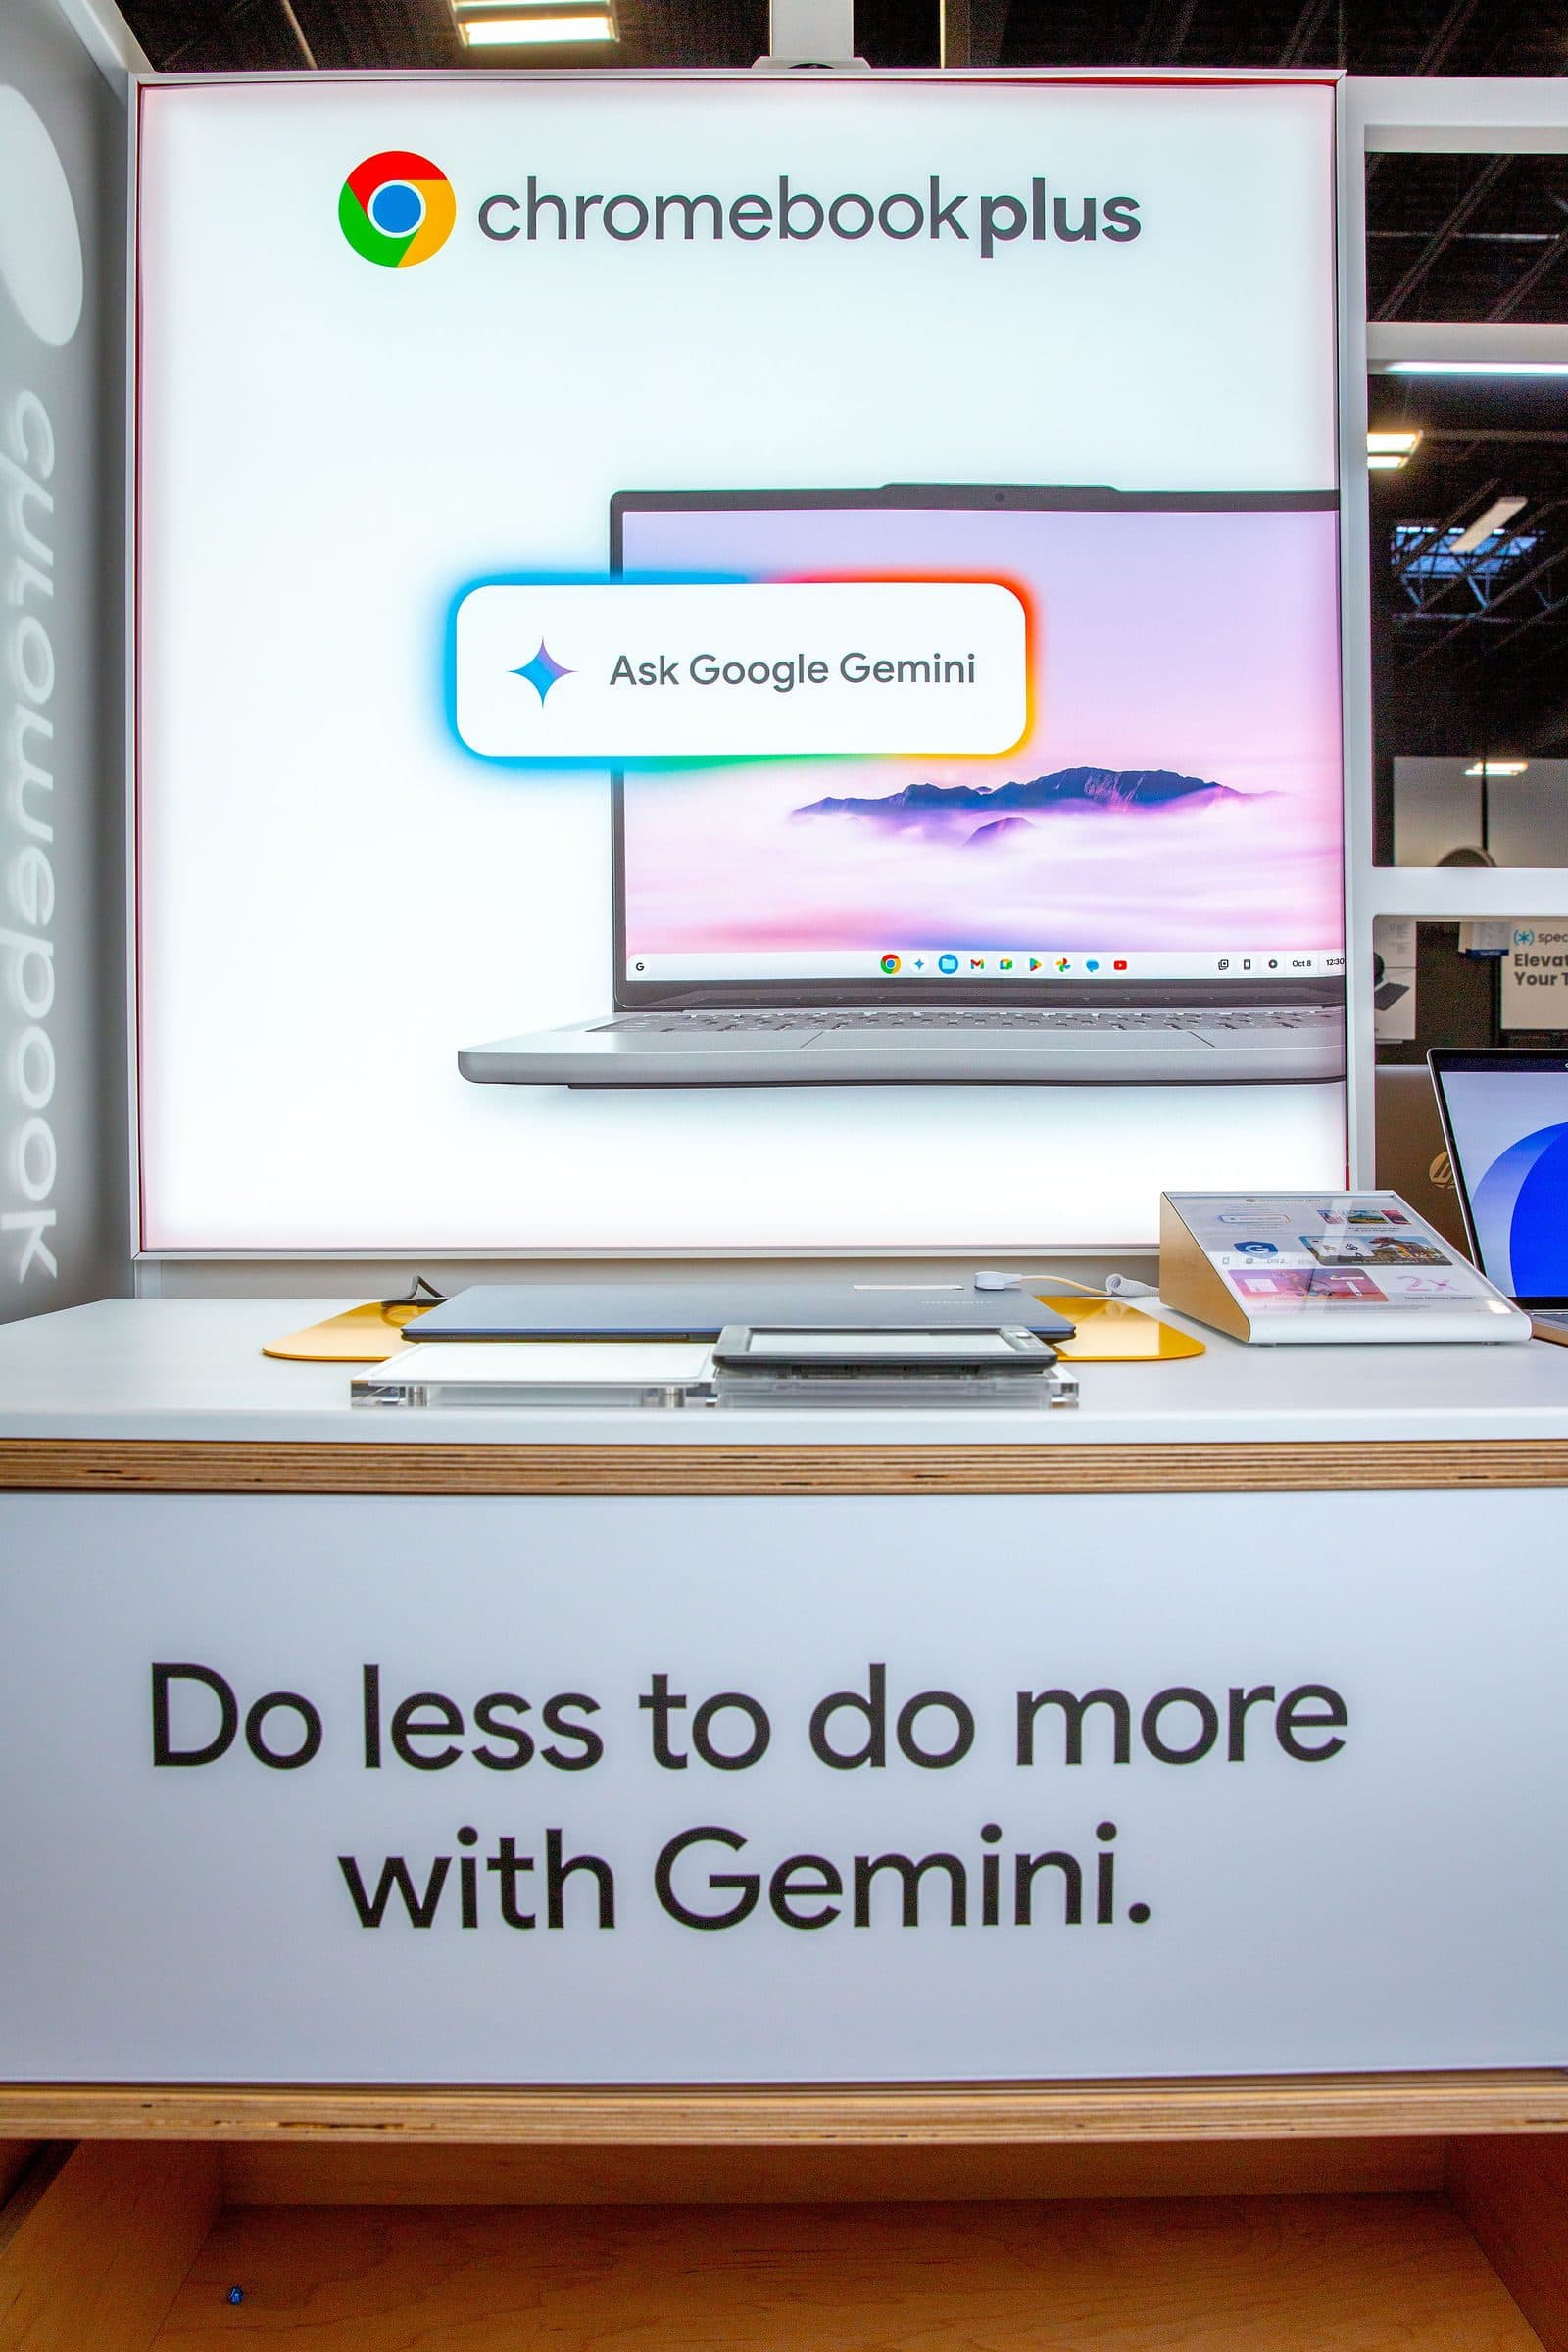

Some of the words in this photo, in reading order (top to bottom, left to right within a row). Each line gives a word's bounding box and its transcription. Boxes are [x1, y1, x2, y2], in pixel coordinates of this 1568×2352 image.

[478, 174, 1142, 259] chromebookplus
[609, 655, 680, 686] Ask
[689, 653, 829, 693] Google
[840, 652, 975, 684] Gemini
[1292, 959, 1305, 968] Oct
[1514, 971, 1557, 987] Your
[151, 1661, 323, 1770] Do
[363, 1664, 604, 1772] less
[638, 1674, 771, 1771] to
[809, 1663, 975, 1770] do
[1016, 1684, 1348, 1766] more
[336, 1826, 615, 1930] with
[654, 1821, 1151, 1931] Gemini.
